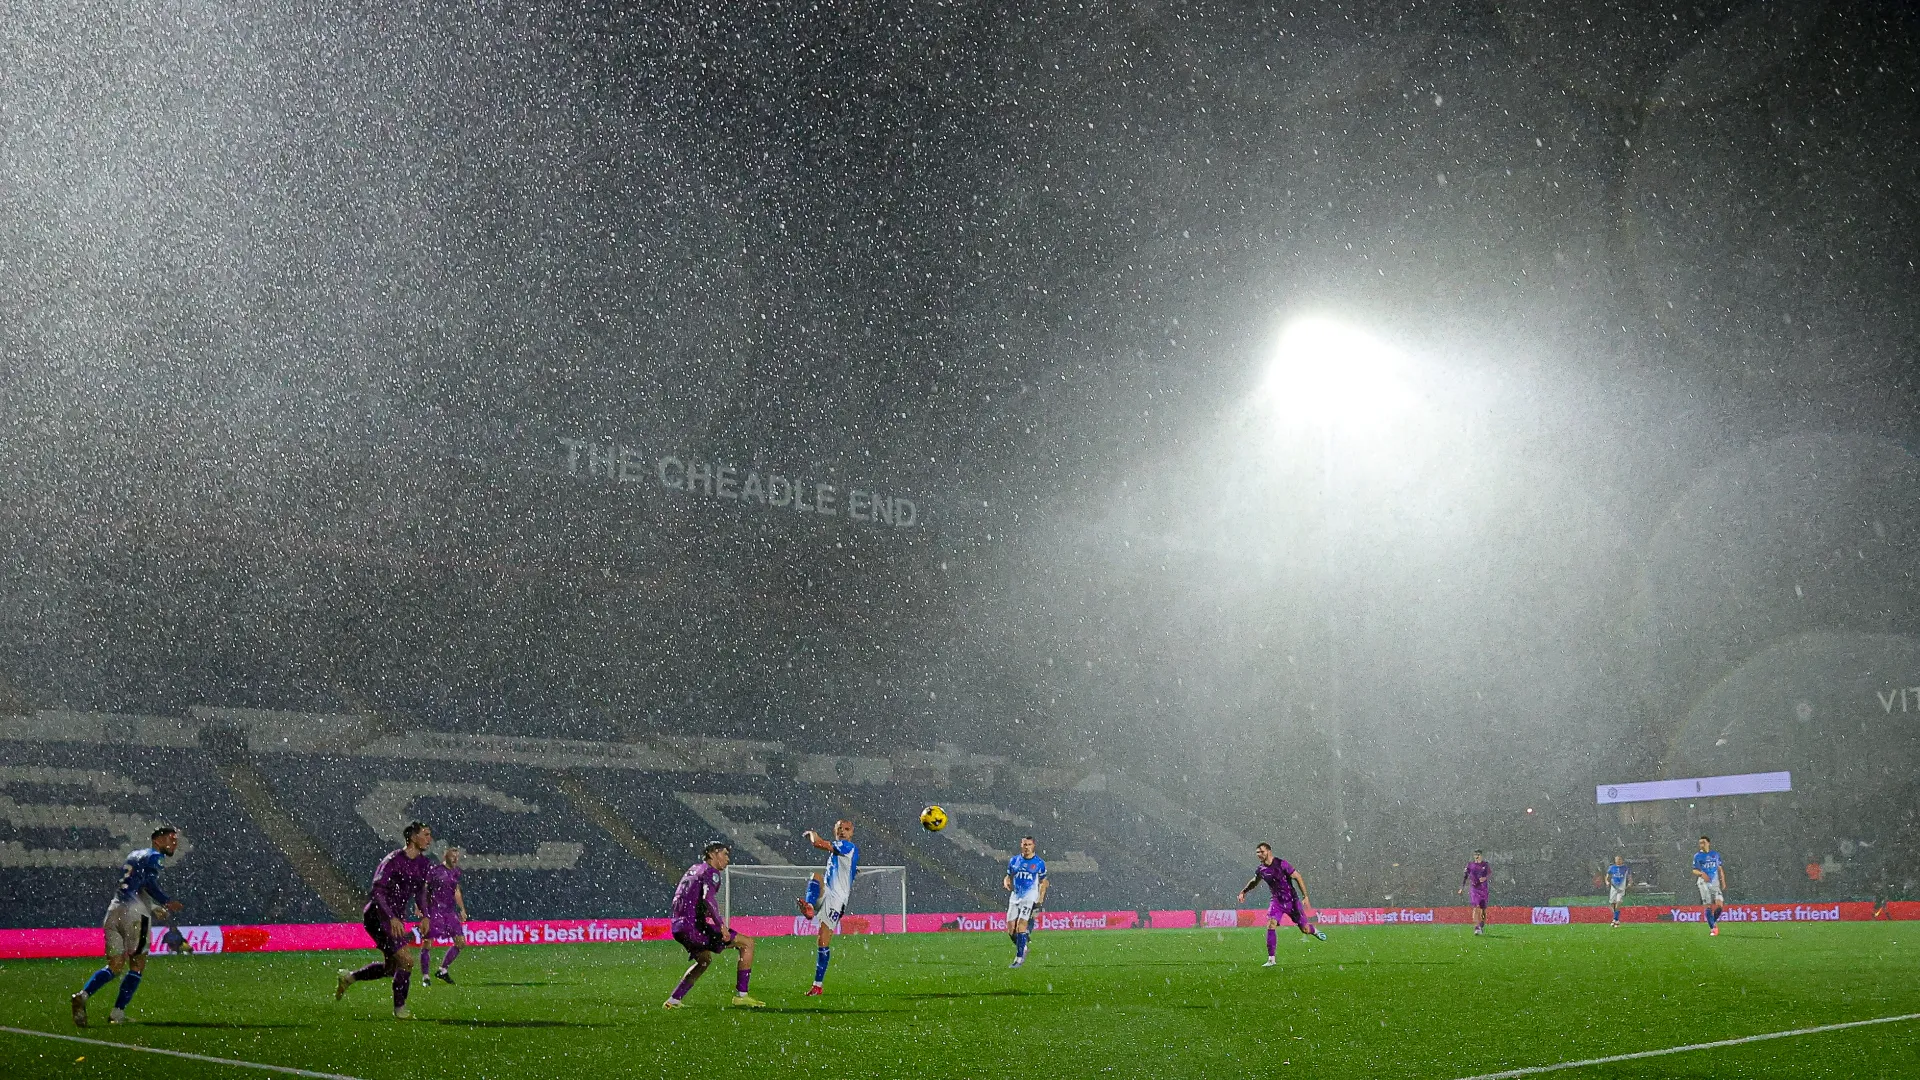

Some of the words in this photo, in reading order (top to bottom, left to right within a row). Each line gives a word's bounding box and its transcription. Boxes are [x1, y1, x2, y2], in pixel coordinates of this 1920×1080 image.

[559, 437, 643, 482] THE
[659, 456, 837, 515] CHEADLE
[849, 488, 917, 527] END
[1015, 871, 1033, 881] VITA
[829, 907, 840, 922] 18
[1316, 911, 1337, 924] Your
[1339, 910, 1374, 923] health's
[1375, 910, 1398, 923] best
[1400, 909, 1434, 922] friend
[1670, 909, 1701, 922] Your
[1705, 907, 1758, 922] alth's
[1761, 907, 1792, 921] best
[1794, 905, 1840, 921] friend
[957, 916, 987, 930] Your
[1041, 914, 1070, 930] best
[1072, 914, 1107, 929] friend
[462, 923, 540, 944] health's
[544, 923, 584, 942] best
[587, 921, 643, 941] friend
